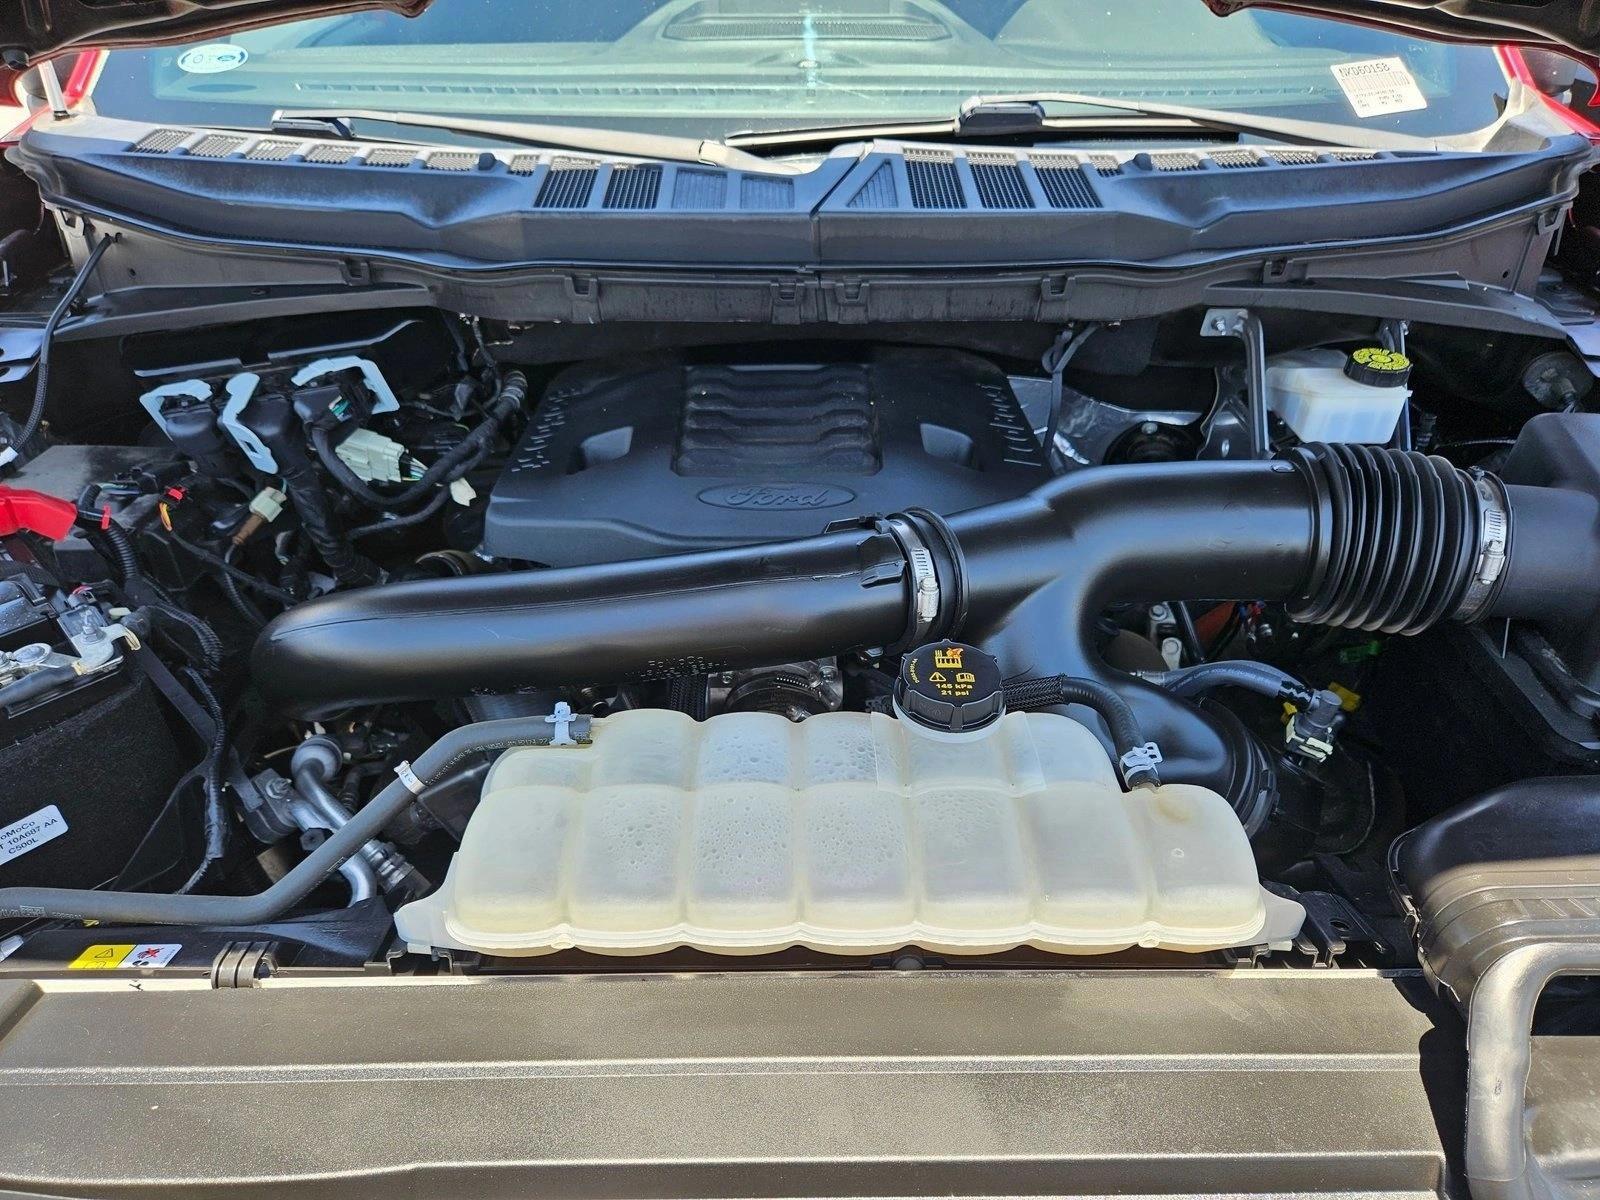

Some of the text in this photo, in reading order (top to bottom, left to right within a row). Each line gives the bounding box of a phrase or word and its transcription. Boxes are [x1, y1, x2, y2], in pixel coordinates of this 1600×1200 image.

[725, 487, 830, 506] Ford
[0, 821, 35, 840] oMoCo
[44, 818, 58, 829] AA
